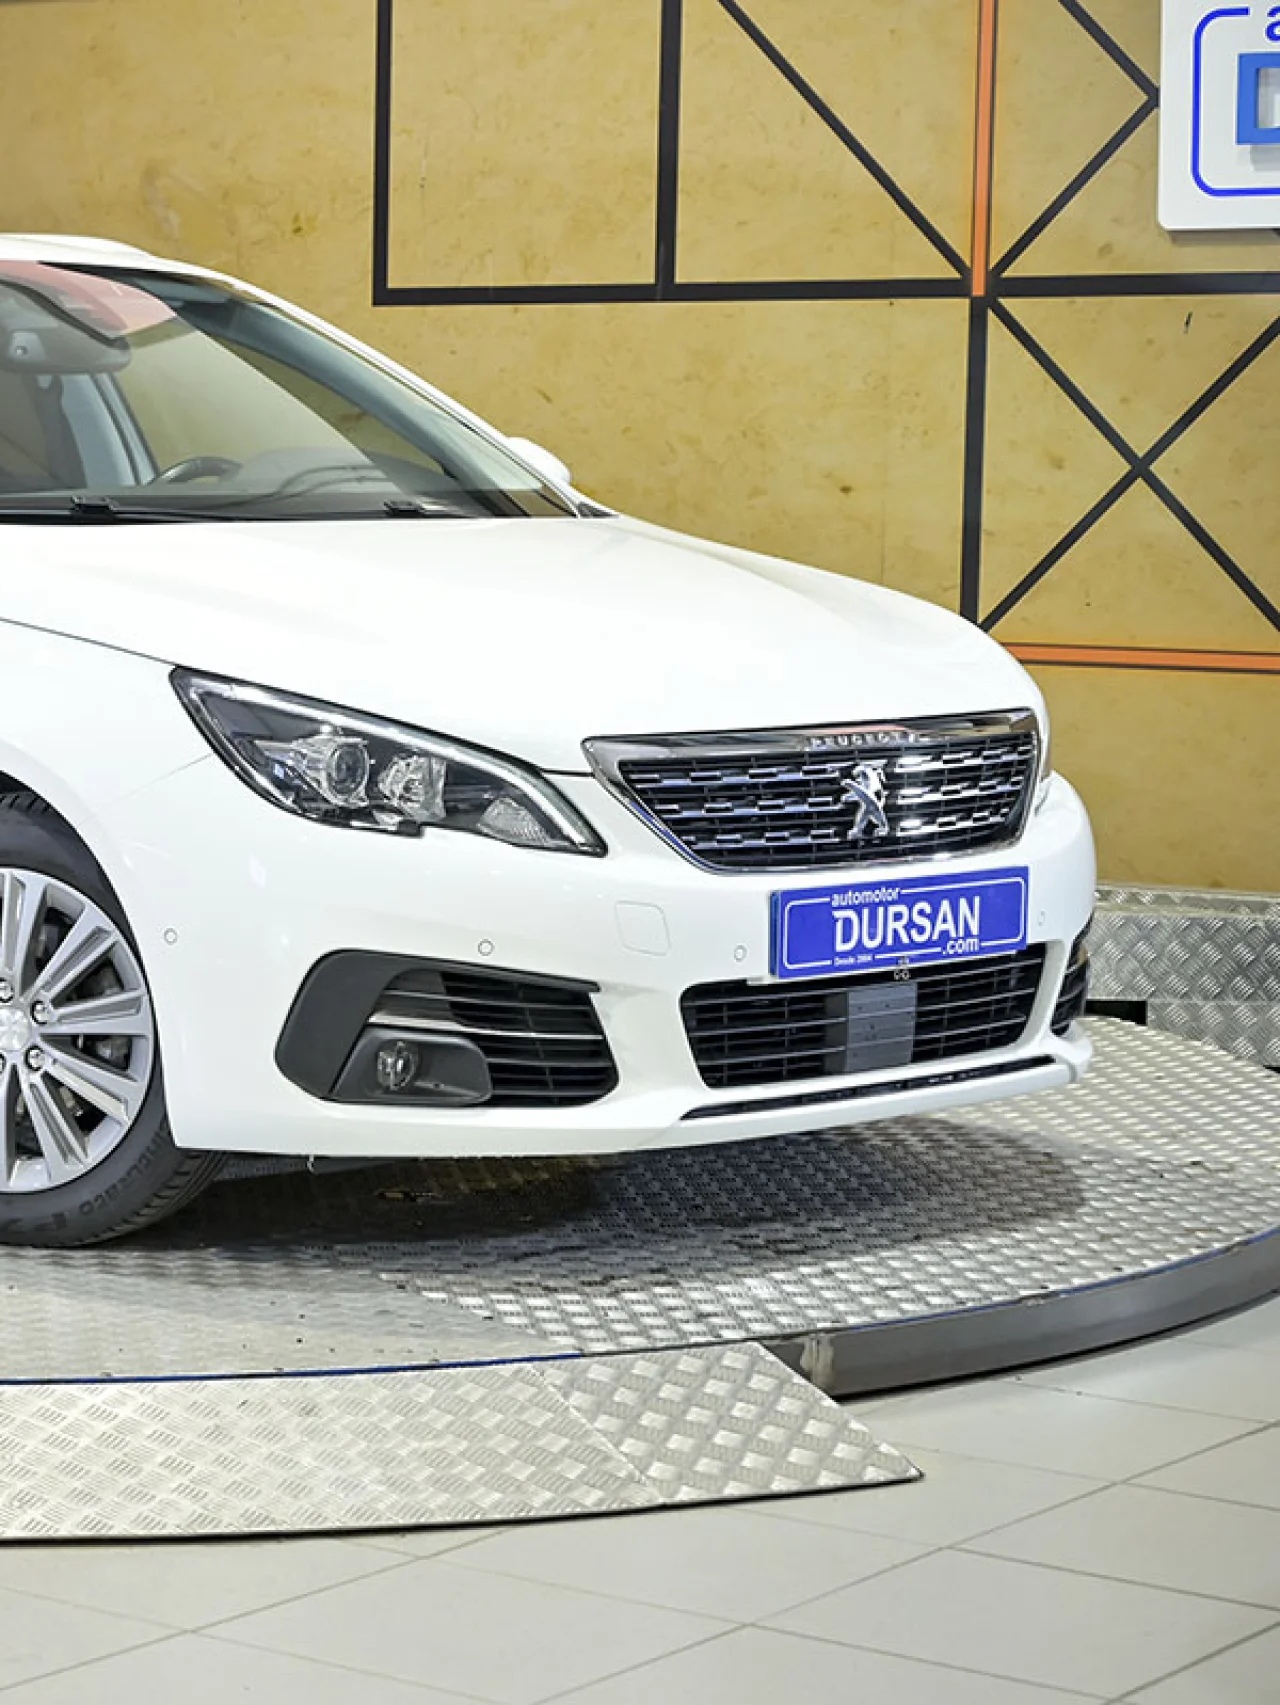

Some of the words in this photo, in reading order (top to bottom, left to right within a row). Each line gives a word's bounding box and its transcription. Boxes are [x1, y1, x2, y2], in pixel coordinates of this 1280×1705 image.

[831, 886, 900, 906] automotor
[832, 896, 980, 952] DURSAN
[941, 937, 980, 955] .com
